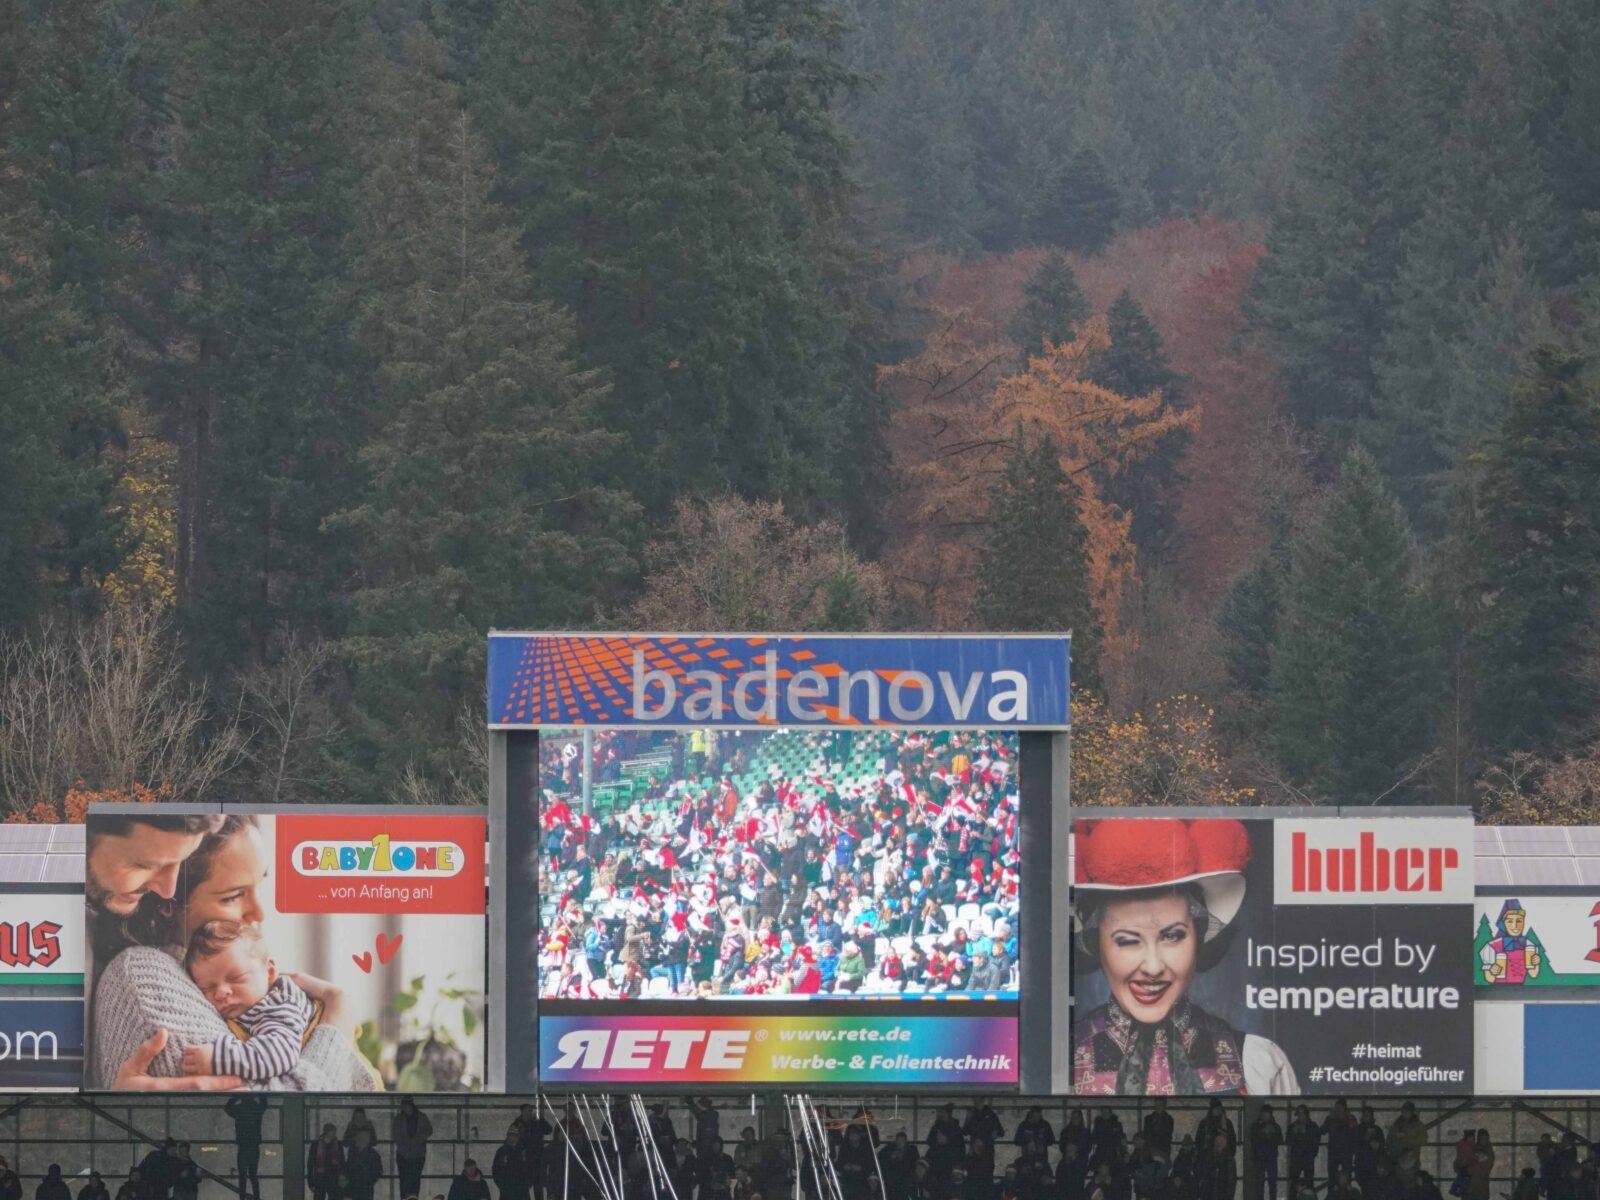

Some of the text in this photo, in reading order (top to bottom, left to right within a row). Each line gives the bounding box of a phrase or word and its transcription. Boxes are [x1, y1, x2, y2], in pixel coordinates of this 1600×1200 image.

[633, 649, 1028, 720] badenova
[1292, 832, 1458, 892] huber
[331, 886, 355, 898] von
[360, 884, 409, 902] Anfang
[413, 885, 432, 898] an!
[1247, 937, 1436, 973] Inspired by
[1246, 984, 1459, 1016] temperature
[779, 1026, 912, 1041] www.rete.de
[1352, 1043, 1422, 1059] #heimat
[771, 1054, 1012, 1069] Werbe- & Folientechnik
[1309, 1067, 1464, 1084] #Technologieführer
